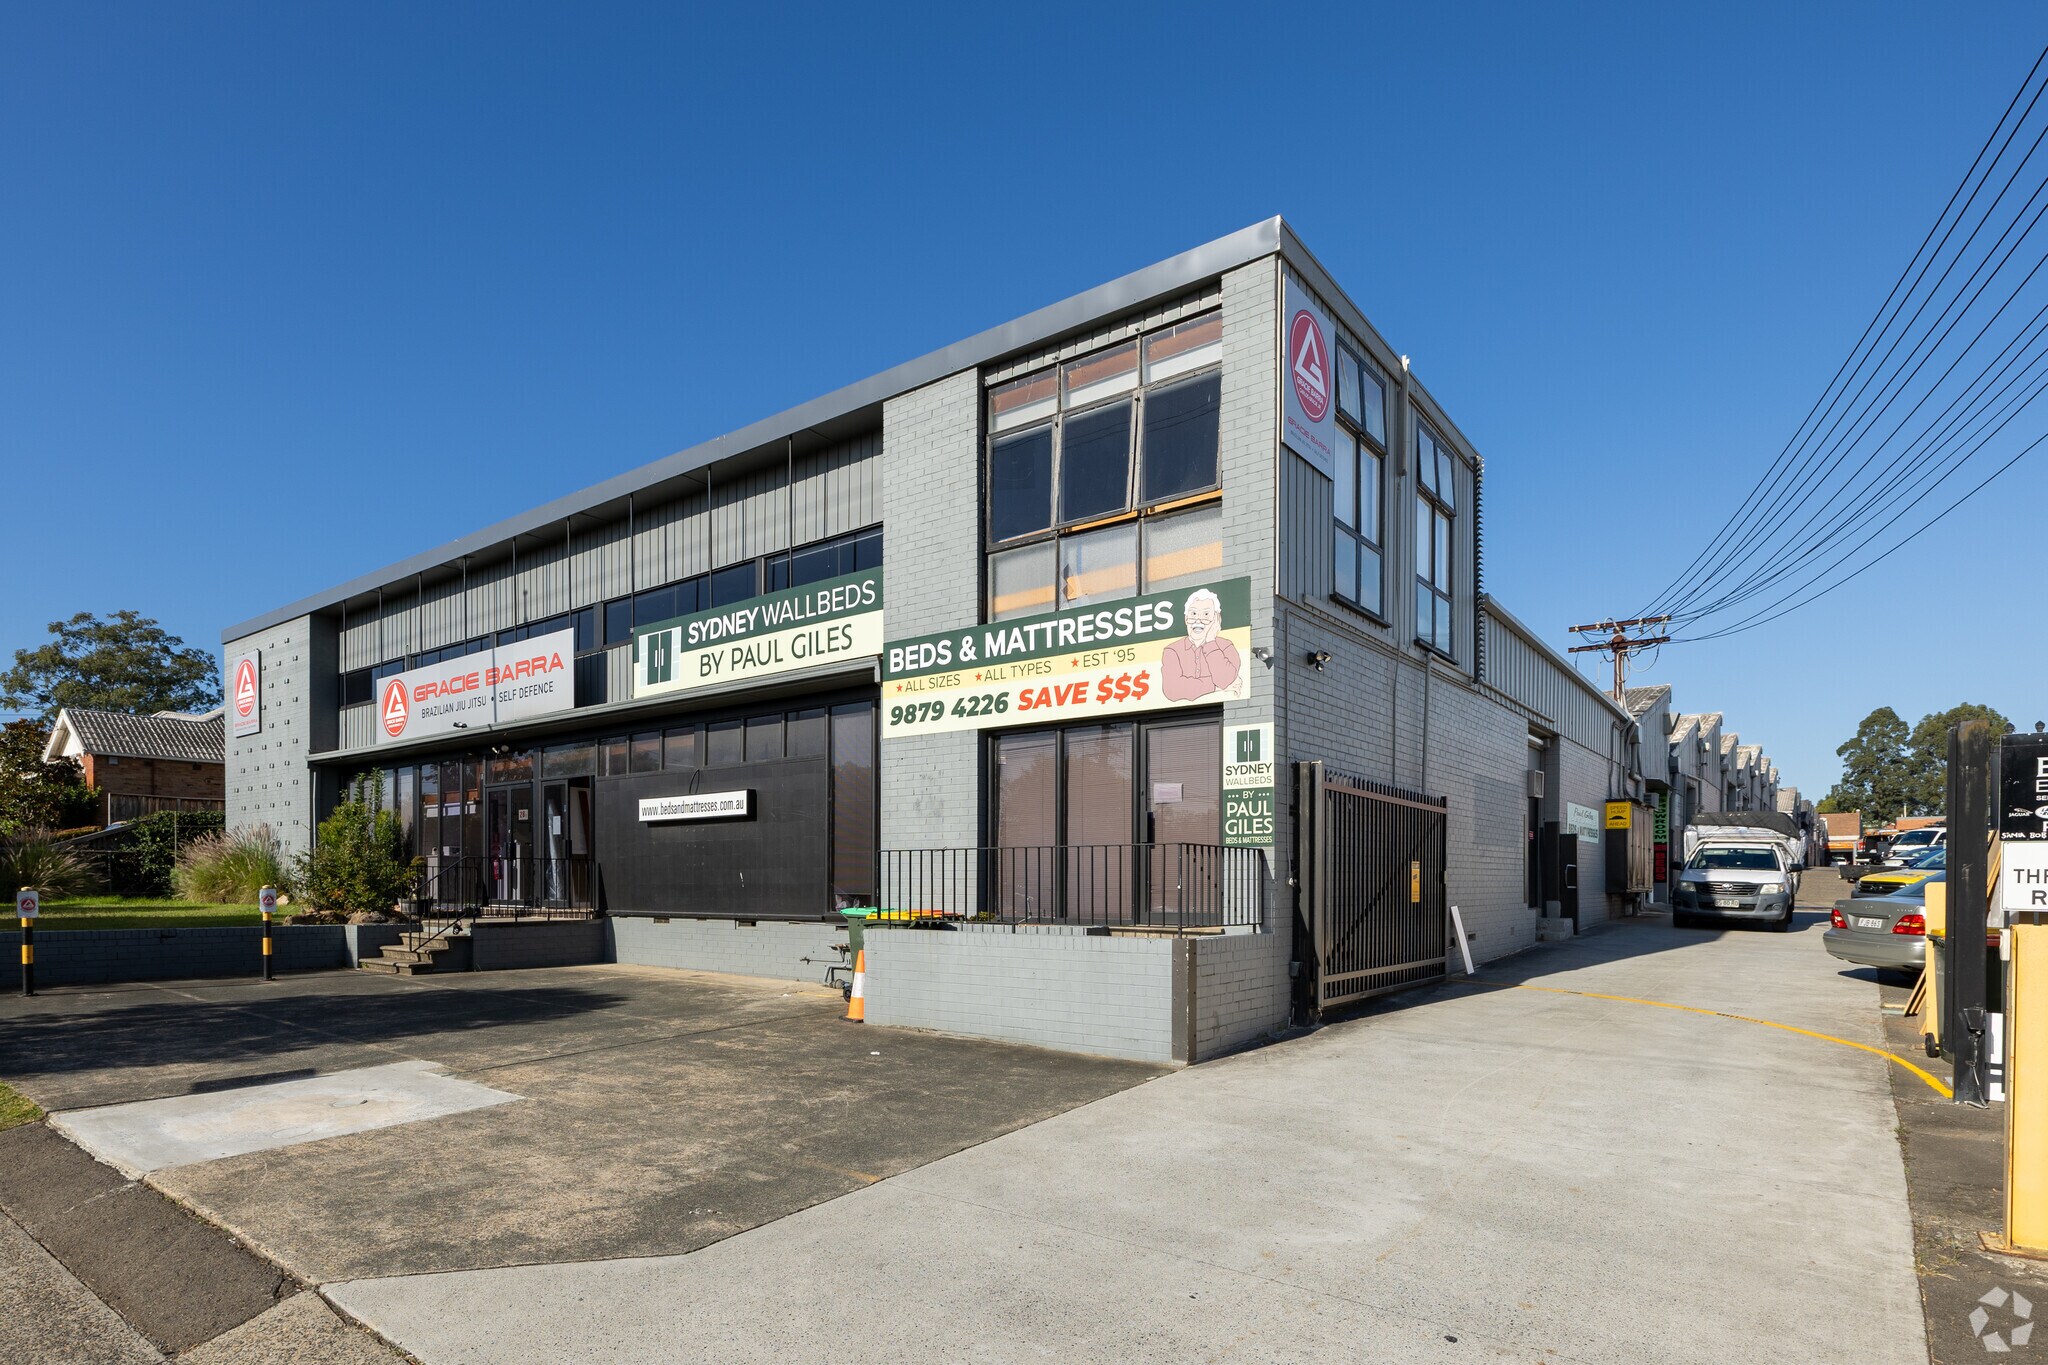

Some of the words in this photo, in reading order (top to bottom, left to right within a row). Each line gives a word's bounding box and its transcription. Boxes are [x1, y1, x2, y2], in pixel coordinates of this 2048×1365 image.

[688, 606, 759, 644] SYDNEY
[762, 579, 876, 625] WALLBEDS
[889, 639, 953, 674] BEDS
[959, 635, 978, 662] &
[984, 600, 1174, 659] MATTRESSES
[700, 650, 725, 677] BY
[731, 639, 784, 672] PAUL
[791, 623, 853, 659] GILES
[1083, 652, 1109, 668] EST
[413, 671, 480, 703] GRACIE
[485, 652, 565, 687] BARRA
[984, 667, 1007, 682] ALL
[1010, 661, 1052, 678] TYPES
[905, 680, 926, 693] ALL
[929, 674, 961, 690] SIZES
[421, 702, 454, 719] BRAZILIAN
[455, 699, 466, 712] JIU
[468, 695, 487, 710] JITSU
[499, 689, 517, 703] SELF
[519, 681, 554, 699] DEFENCE
[890, 700, 945, 726] 9879
[951, 692, 1010, 718] 4226
[1017, 681, 1090, 711] SAVE
[1096, 670, 1151, 705] $$$
[1225, 763, 1273, 776] SYDNEY
[1225, 775, 1273, 786] WALLBEDS
[1242, 790, 1255, 799] BY
[641, 799, 744, 816] www.bedsandmattresses.com.au
[1226, 800, 1272, 818] PAUL
[1225, 817, 1274, 835] GILES
[1225, 836, 1238, 844] BEDS
[1242, 835, 1273, 844] MATTRESSES
